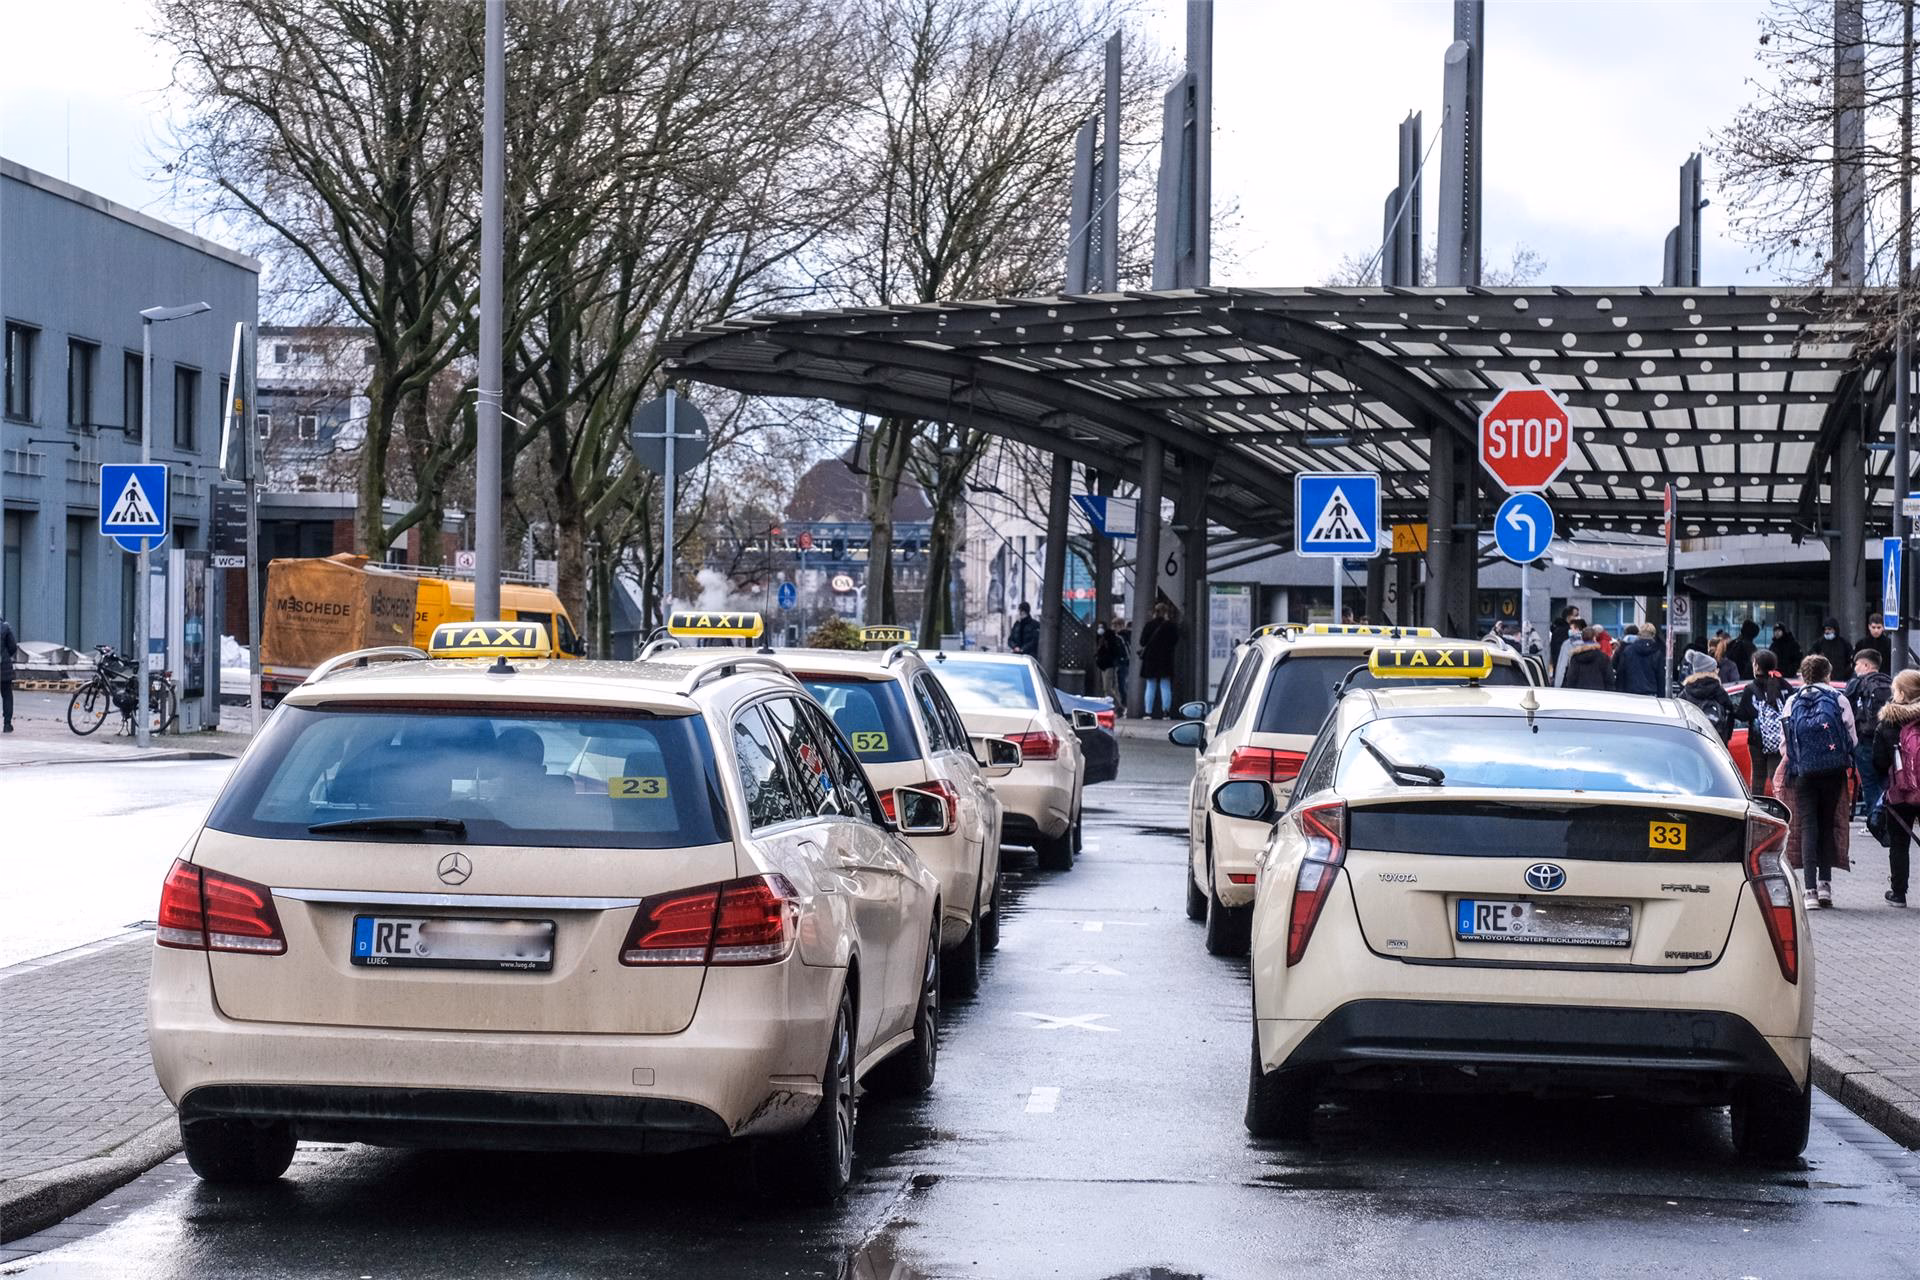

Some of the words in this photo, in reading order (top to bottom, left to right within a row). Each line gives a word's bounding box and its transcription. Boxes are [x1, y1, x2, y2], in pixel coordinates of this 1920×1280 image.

[1488, 418, 1562, 459] STOP
[218, 557, 235, 566] WC
[1165, 551, 1178, 576] 6
[1388, 583, 1397, 604] 5
[683, 615, 744, 628] TAXI
[440, 628, 533, 646] TAXI
[870, 631, 900, 639] TAXI
[1339, 626, 1407, 635] TAXI
[1390, 650, 1469, 666] TAXI
[857, 733, 885, 750] 52
[622, 779, 660, 794] 23
[1653, 826, 1682, 845] 33
[1379, 873, 1418, 882] TOYOTA
[1463, 920, 1470, 928] D
[1476, 905, 1507, 931] RE
[359, 941, 367, 950] D
[375, 923, 412, 953] RE
[367, 957, 389, 965] LUEG.
[500, 961, 536, 970] www.lueg.de
